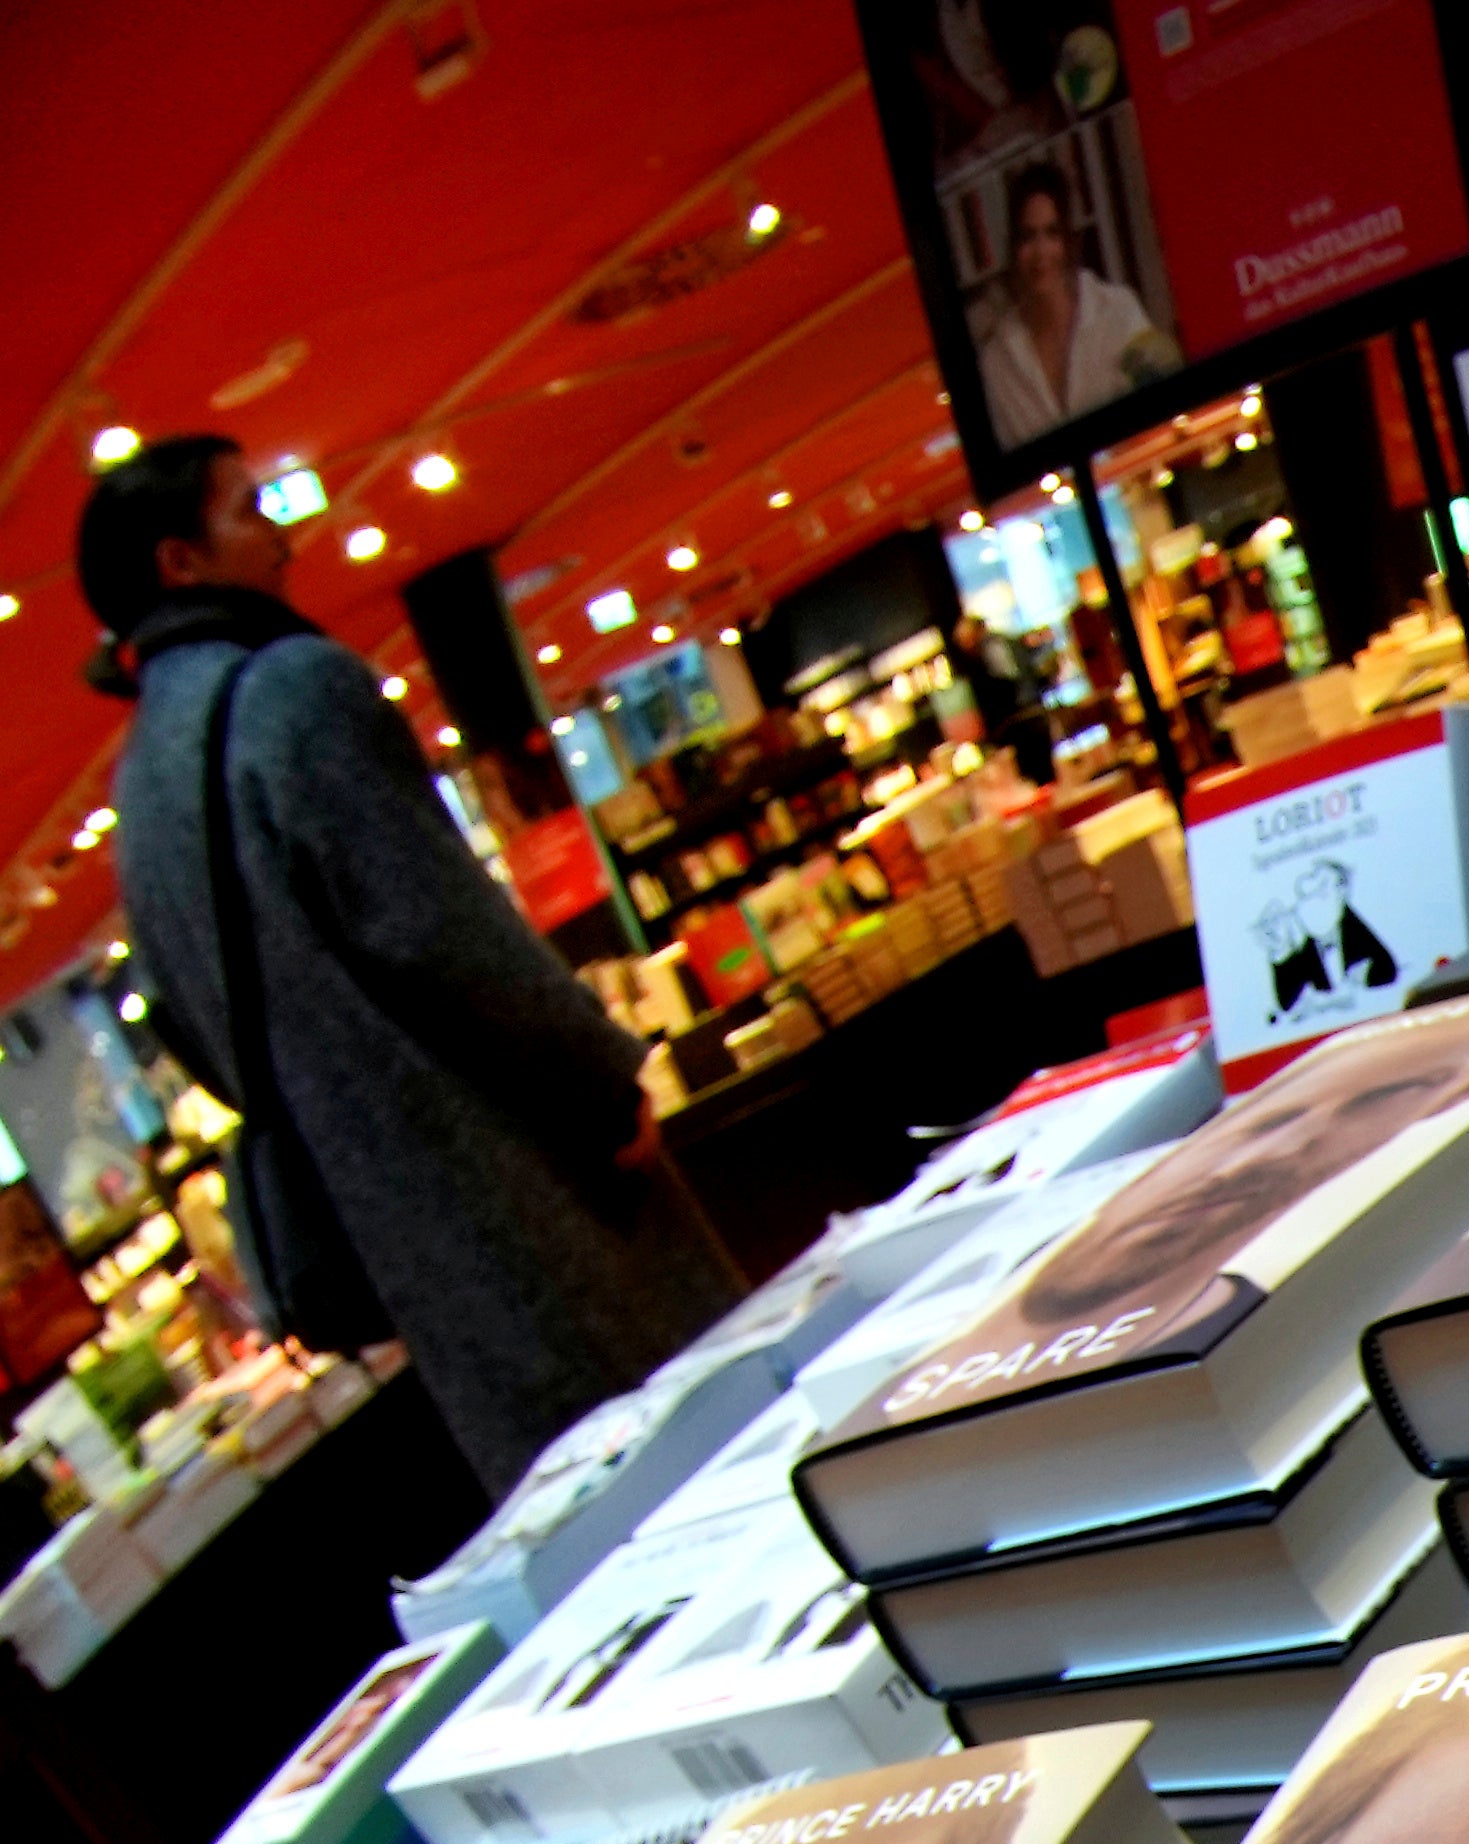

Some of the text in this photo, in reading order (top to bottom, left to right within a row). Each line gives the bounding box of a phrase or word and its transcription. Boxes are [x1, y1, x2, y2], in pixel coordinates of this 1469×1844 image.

[1253, 781, 1368, 845] LORIOT
[884, 1306, 1157, 1415] SPARE
[862, 1766, 1042, 1834] HARRY
